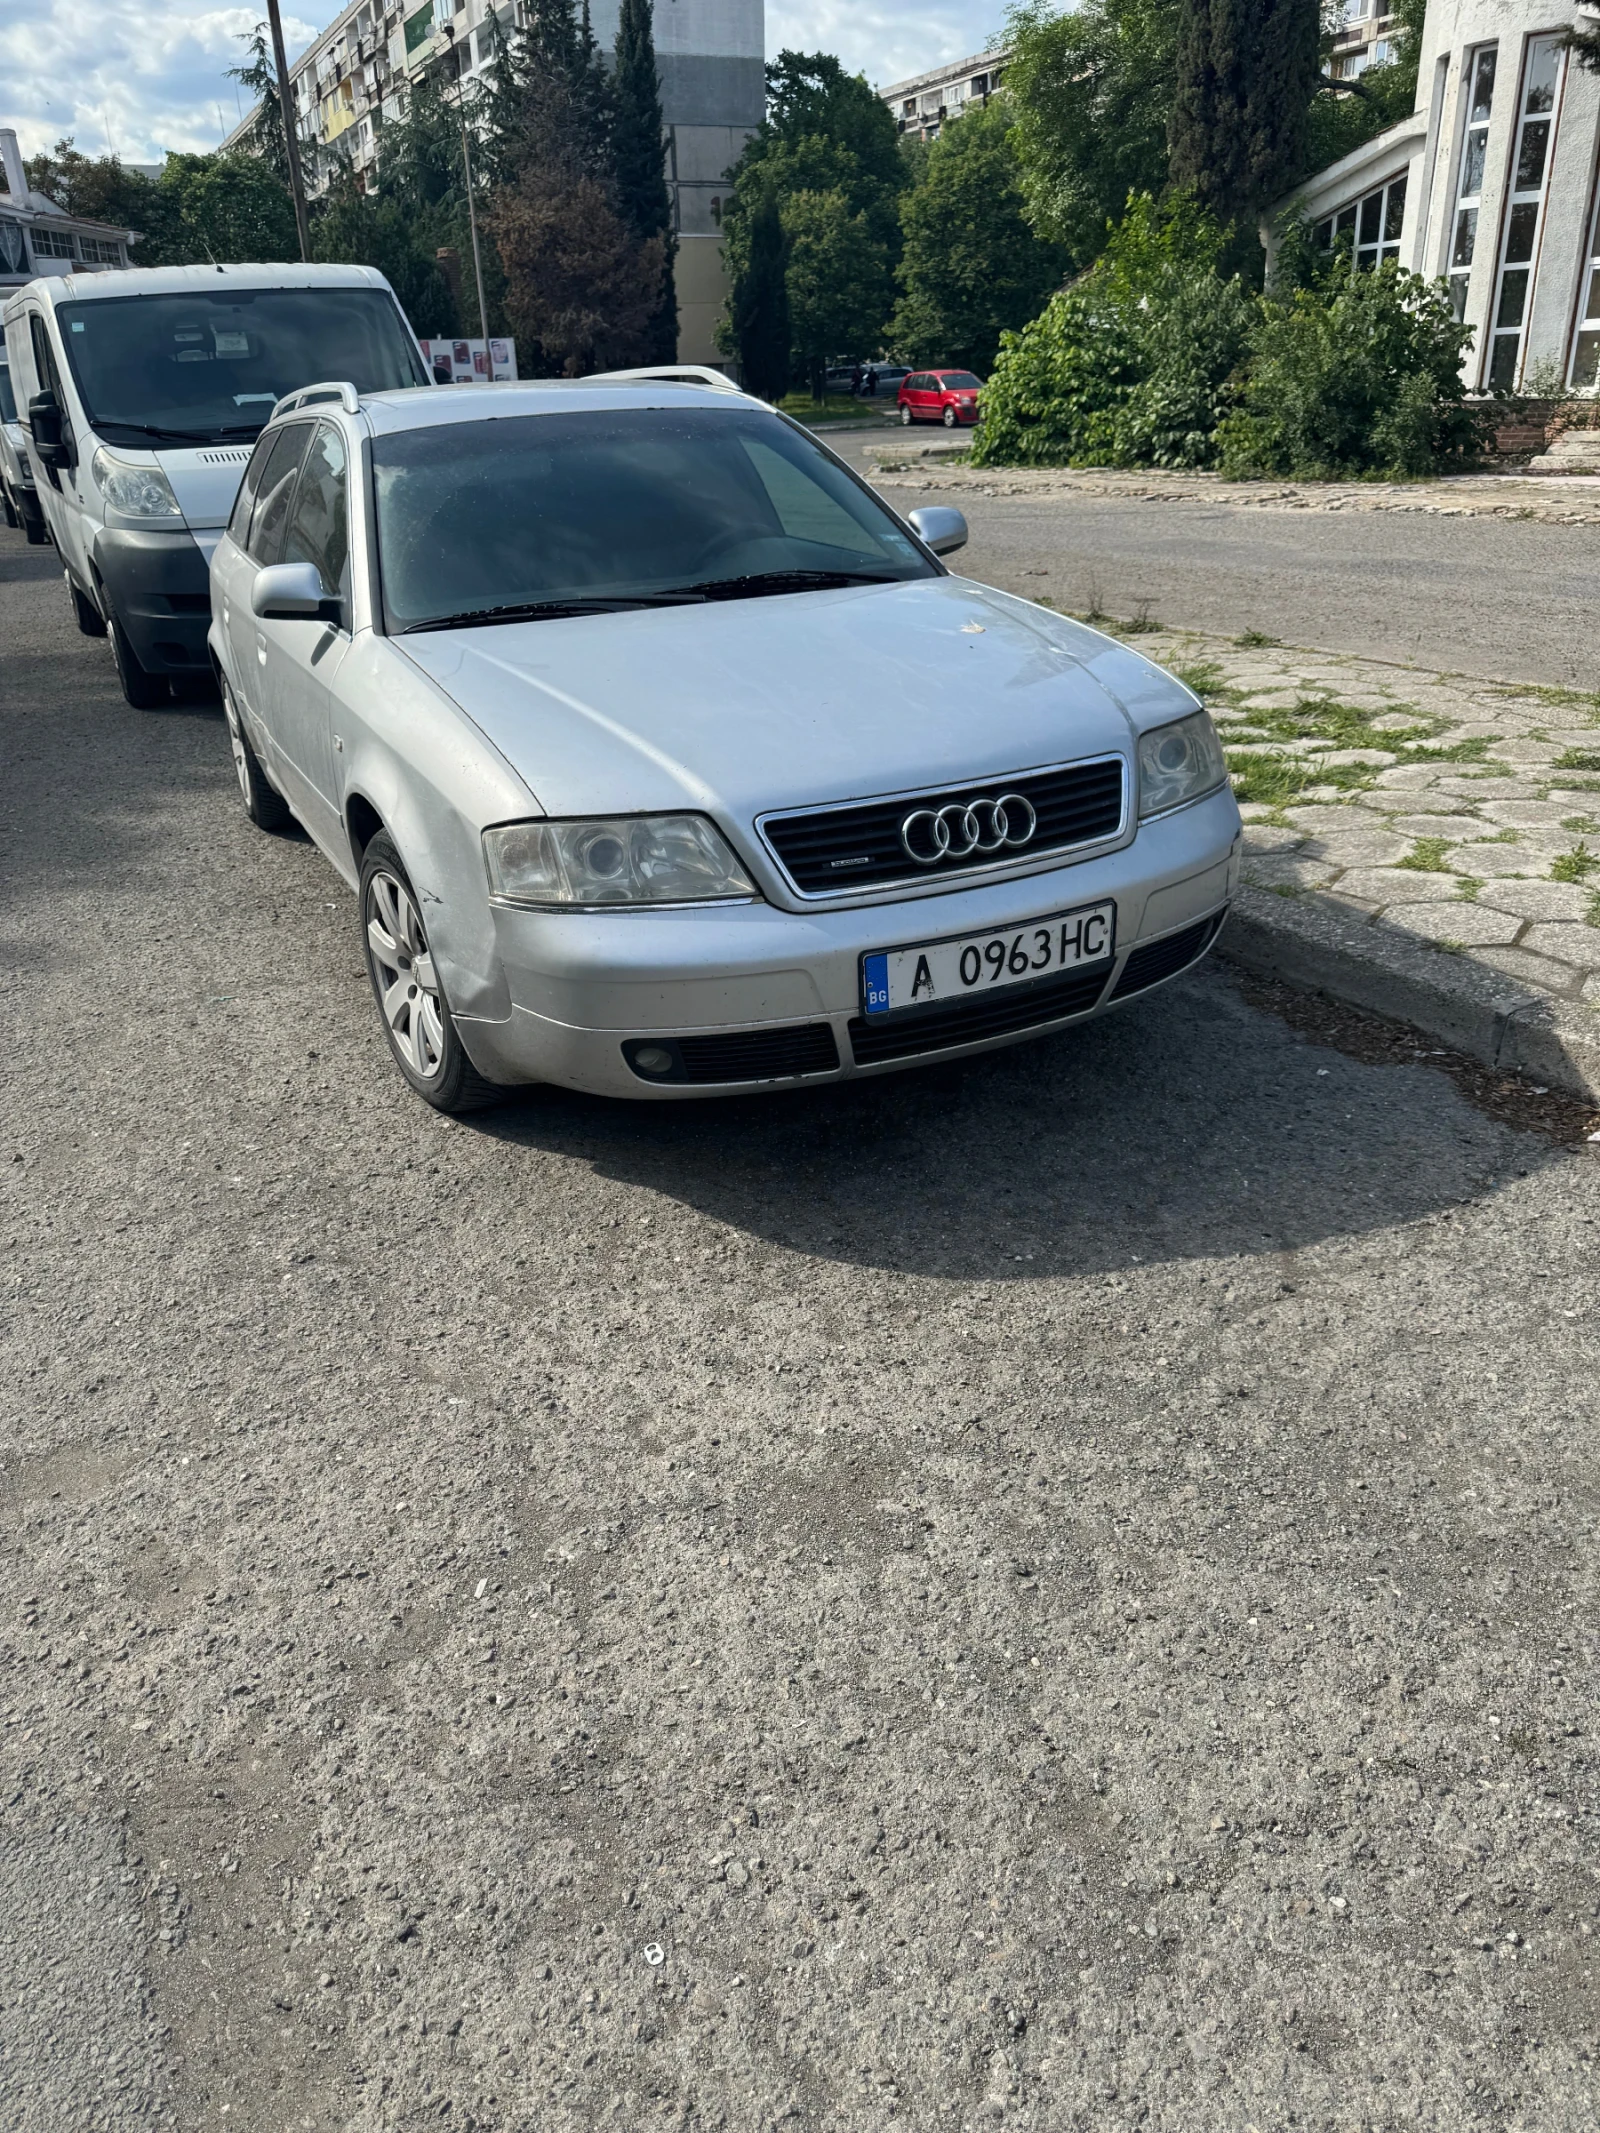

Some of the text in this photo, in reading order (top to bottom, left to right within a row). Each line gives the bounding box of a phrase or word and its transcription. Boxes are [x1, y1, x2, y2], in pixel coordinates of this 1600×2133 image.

[911, 914, 1105, 998] A 0963 HC
[869, 990, 887, 1004] BG
